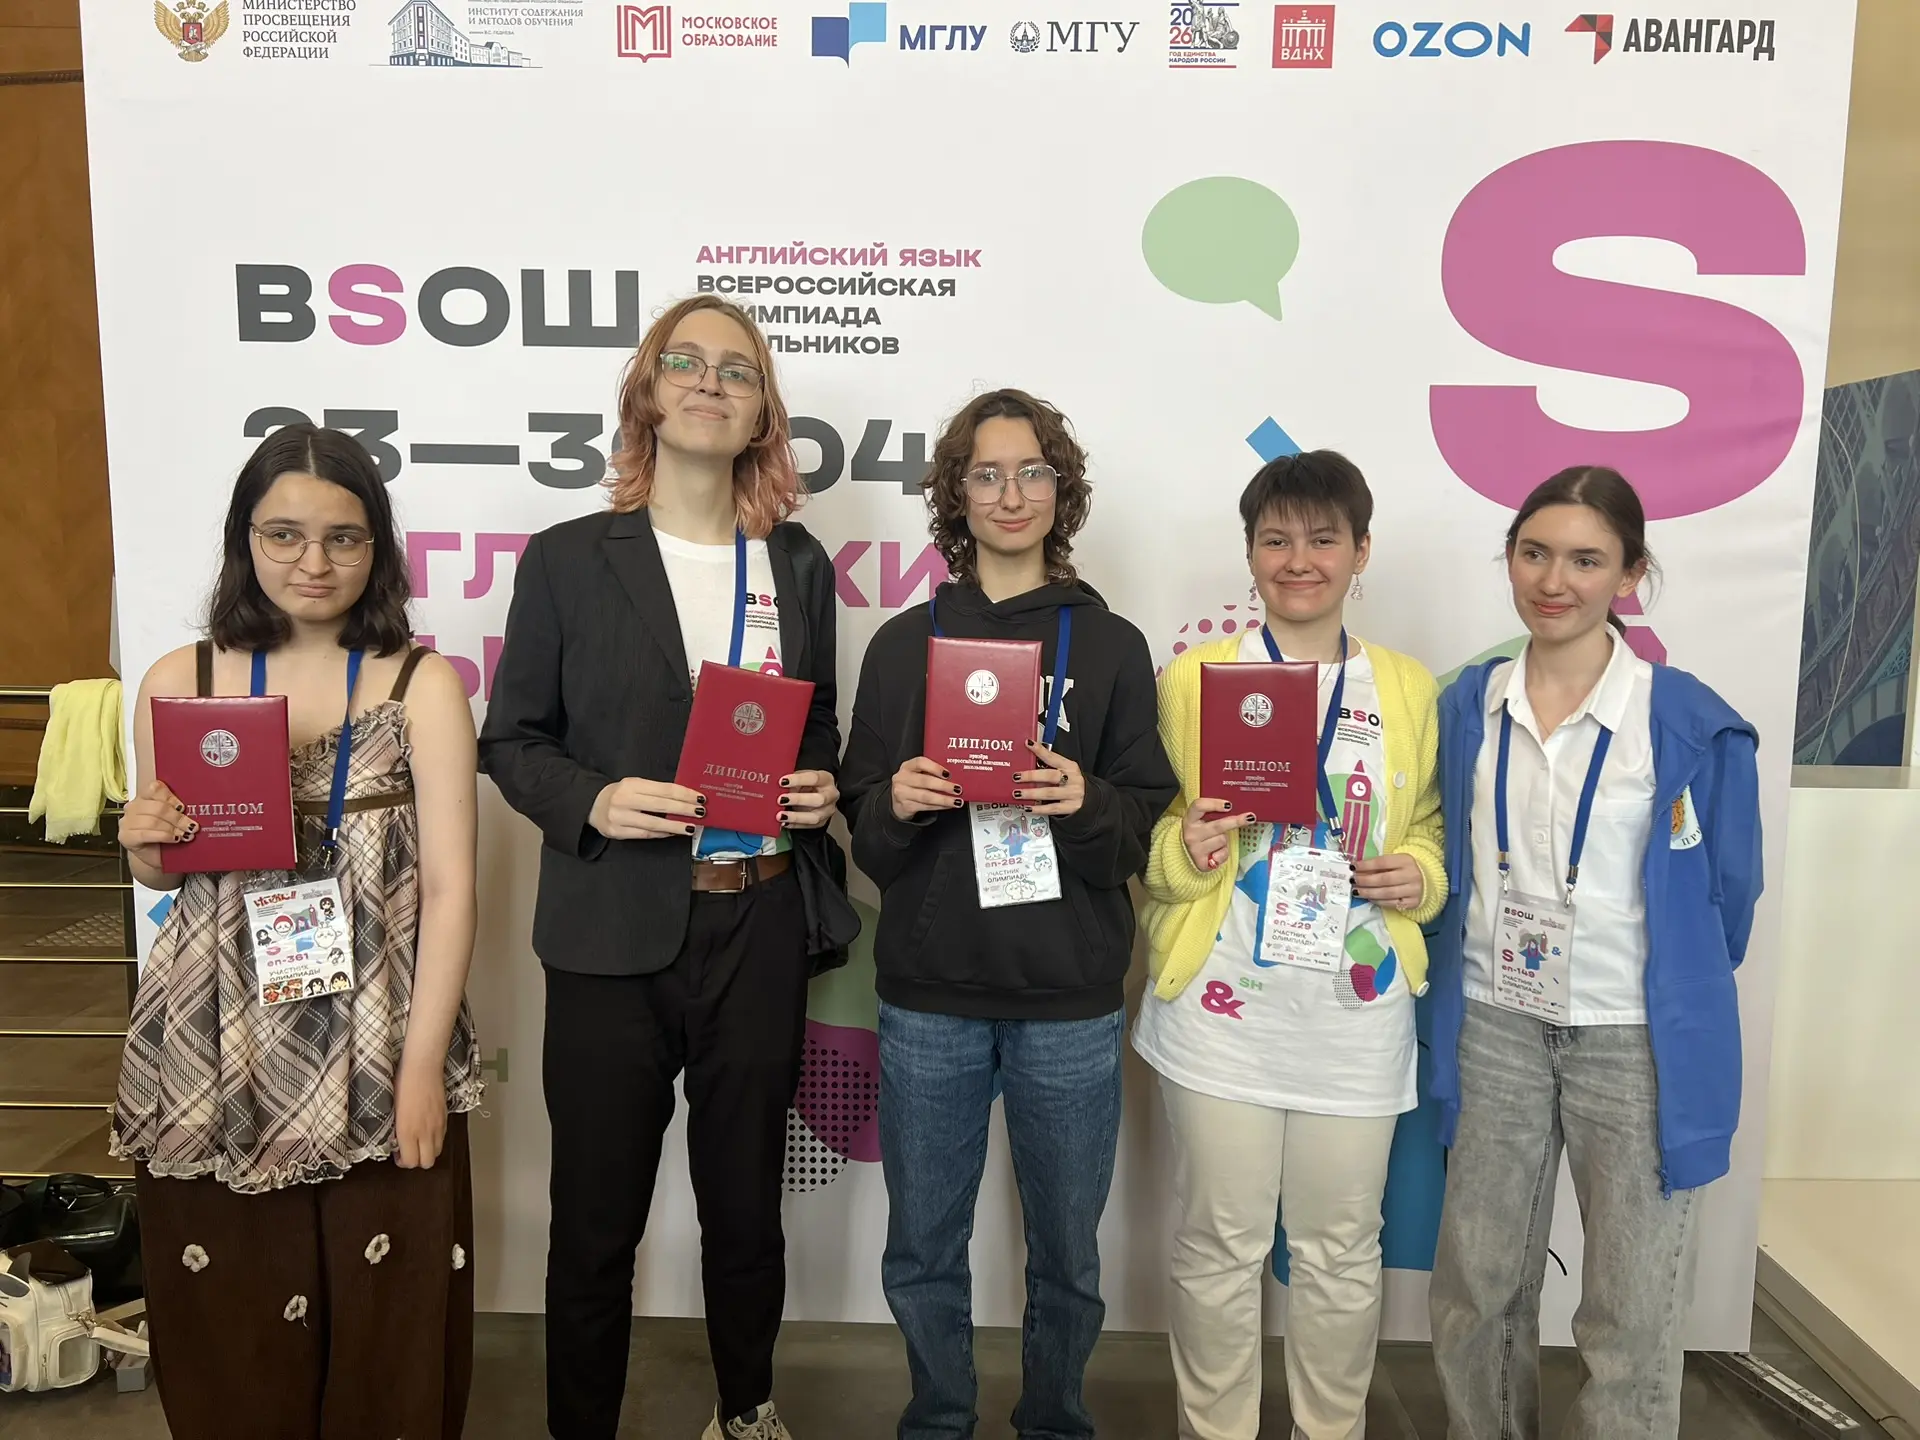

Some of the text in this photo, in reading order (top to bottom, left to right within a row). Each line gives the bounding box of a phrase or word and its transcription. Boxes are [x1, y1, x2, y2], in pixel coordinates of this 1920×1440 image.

[242, 0, 357, 11] МИНИСТЕРСТВО
[468, 8, 584, 17] ИНСТИТУТ СОДЕРЖАНИЯ
[243, 14, 351, 27] ПРОСВЕЩЕНИЯ
[468, 17, 574, 26] И МЕТОДОВ ОБУЧЕНИЯ
[681, 16, 778, 30] МОСКОВСКОЕ
[242, 29, 337, 43] РОССИЙСКОЙ
[681, 33, 778, 47] ОБРАЗОВАНИЕ
[899, 24, 988, 51] МГЛУ
[1046, 21, 1141, 53] МГУ
[1373, 21, 1531, 58] OZON
[1623, 18, 1776, 62] АВАНГАРД
[242, 46, 329, 60] ФЕДЕРАЦИИ
[1281, 48, 1325, 61] ВДНХ
[696, 240, 983, 268] АНГЛИЙСКИЙ ЯЗЫК
[697, 271, 957, 297] ВСЕРОССИЙСКАЯ
[740, 305, 882, 328] ИМПИАДА
[768, 335, 900, 355] ЛЬНИКОВ
[947, 737, 1014, 751] ДИПЛОМ
[702, 763, 771, 784] ДИПЛОМ
[1223, 760, 1291, 773] ДИПЛОМ
[187, 802, 264, 818] ДИПЛОМ
